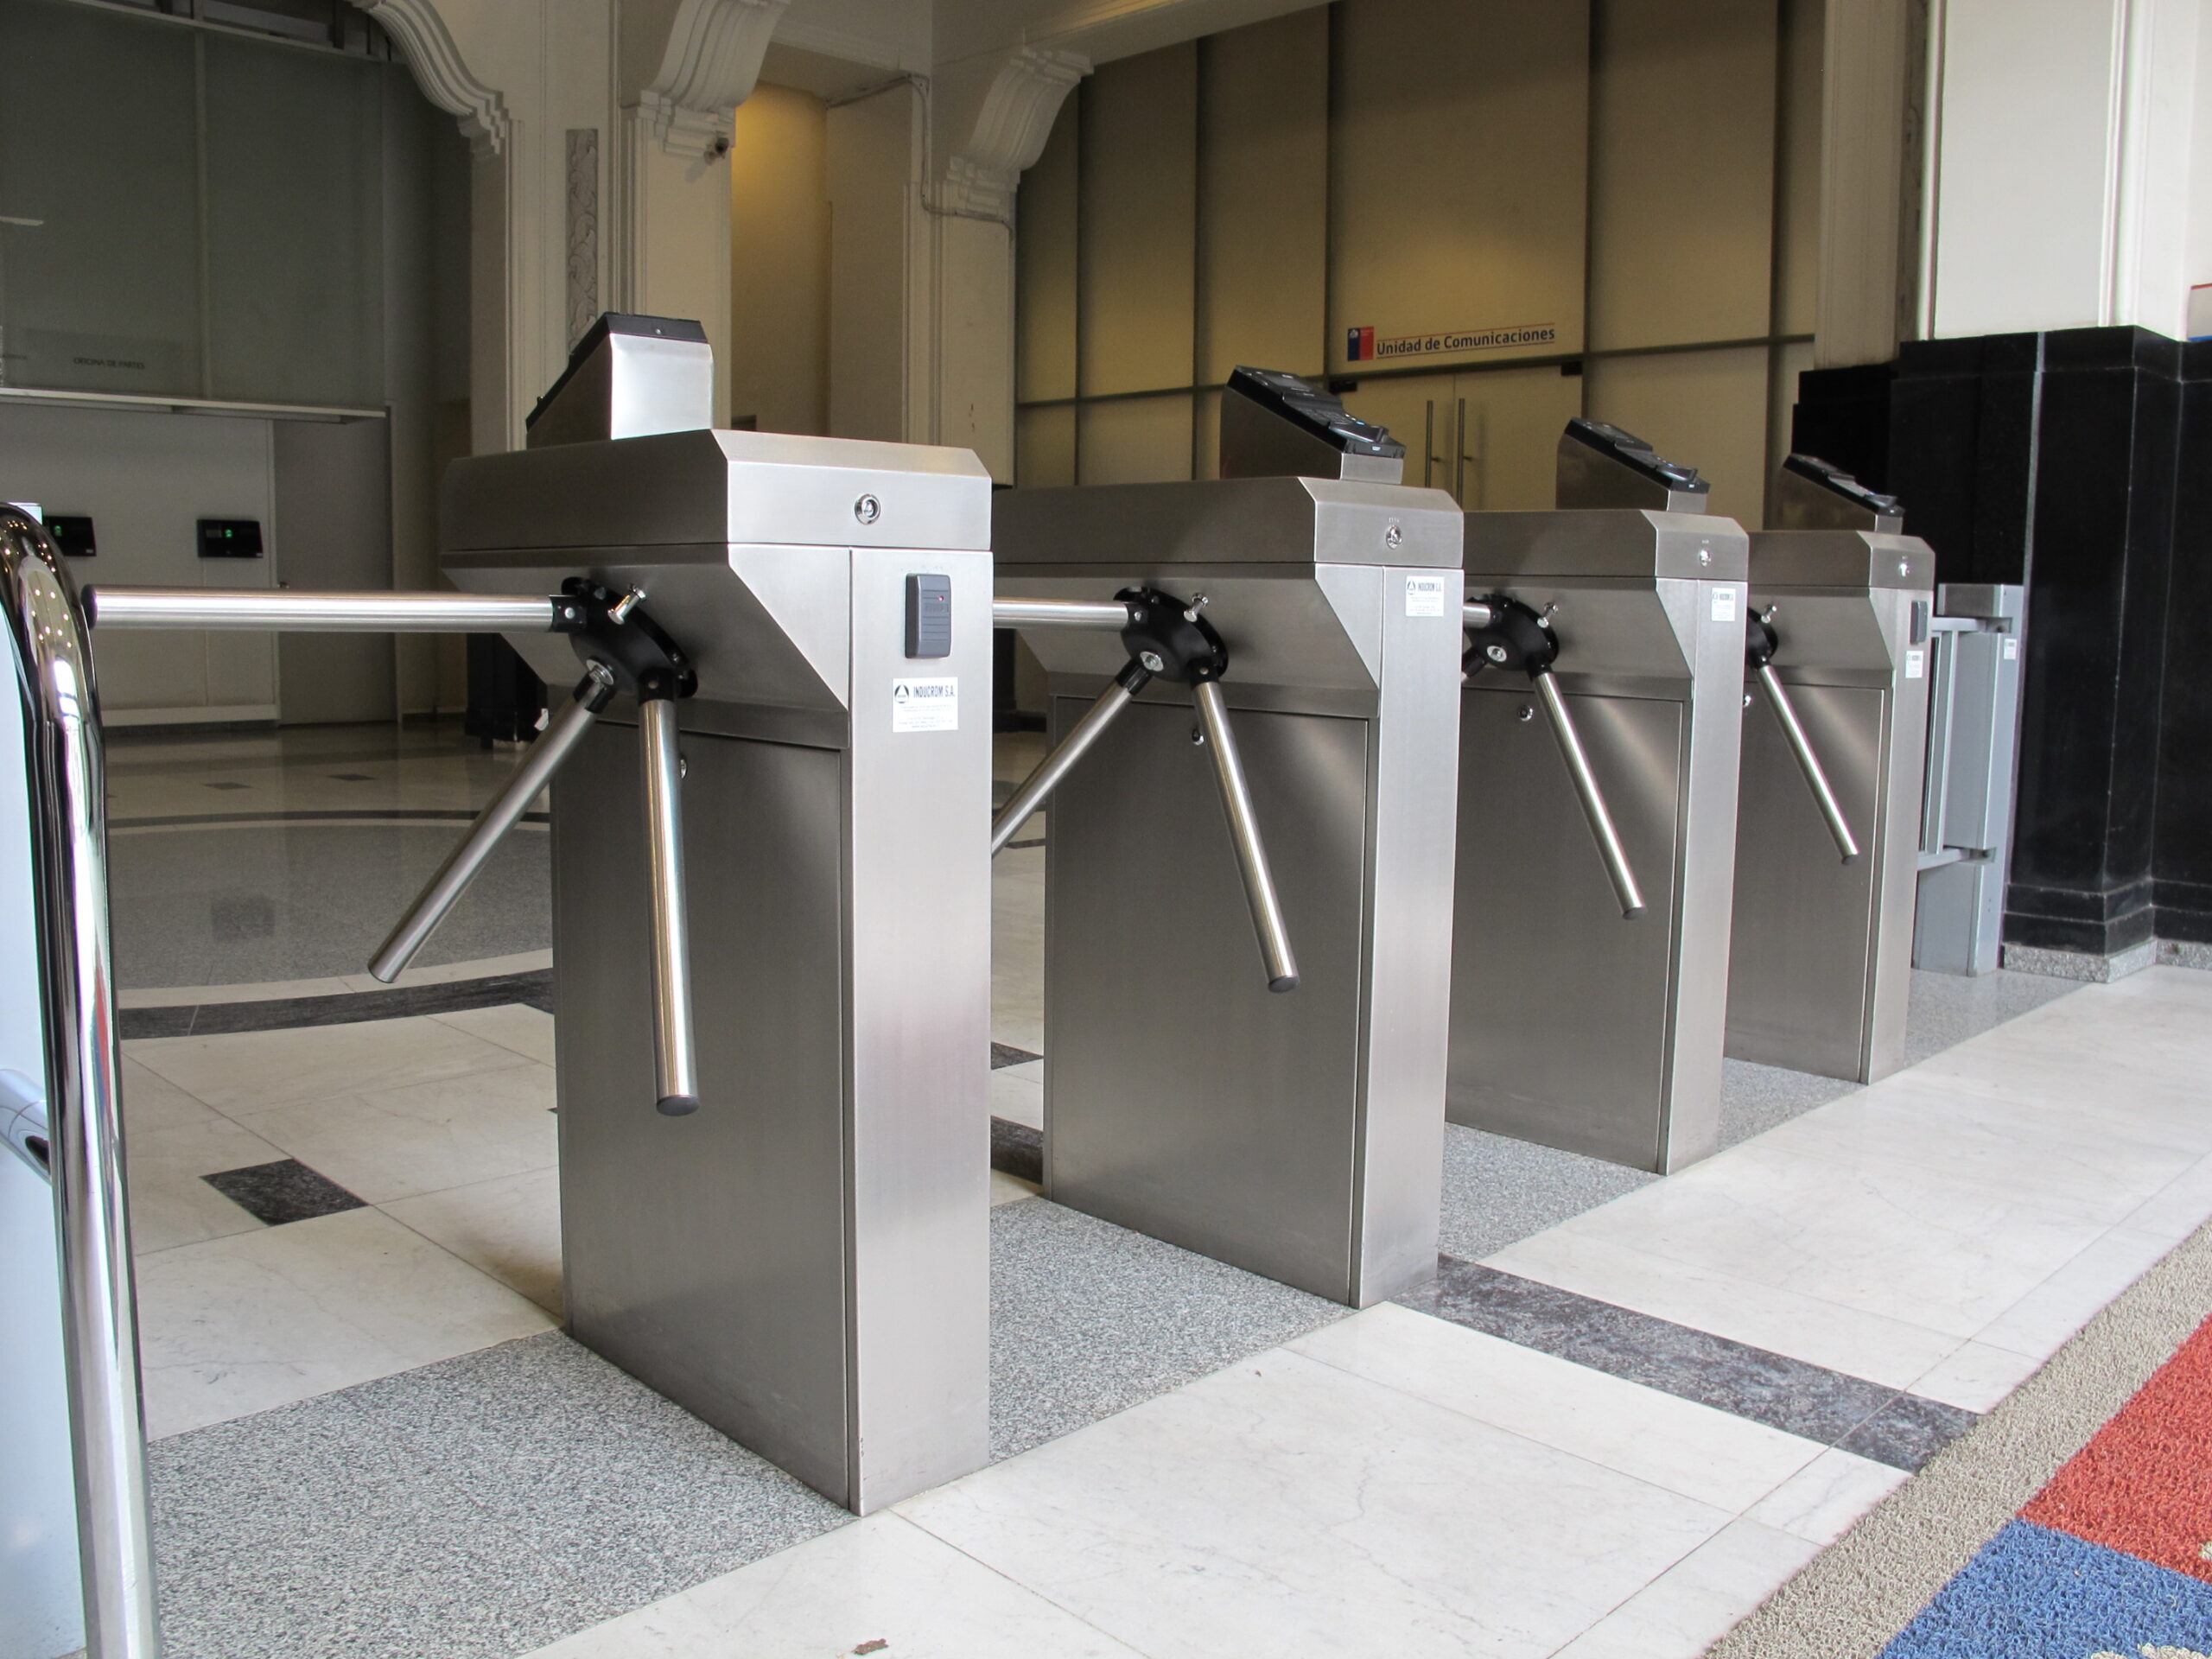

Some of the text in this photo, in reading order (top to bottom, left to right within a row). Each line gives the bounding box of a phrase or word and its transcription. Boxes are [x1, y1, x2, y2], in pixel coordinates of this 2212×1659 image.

[1377, 328, 1554, 355] Unidad de Comunicaciones
[913, 685, 943, 698] INDUCROM
